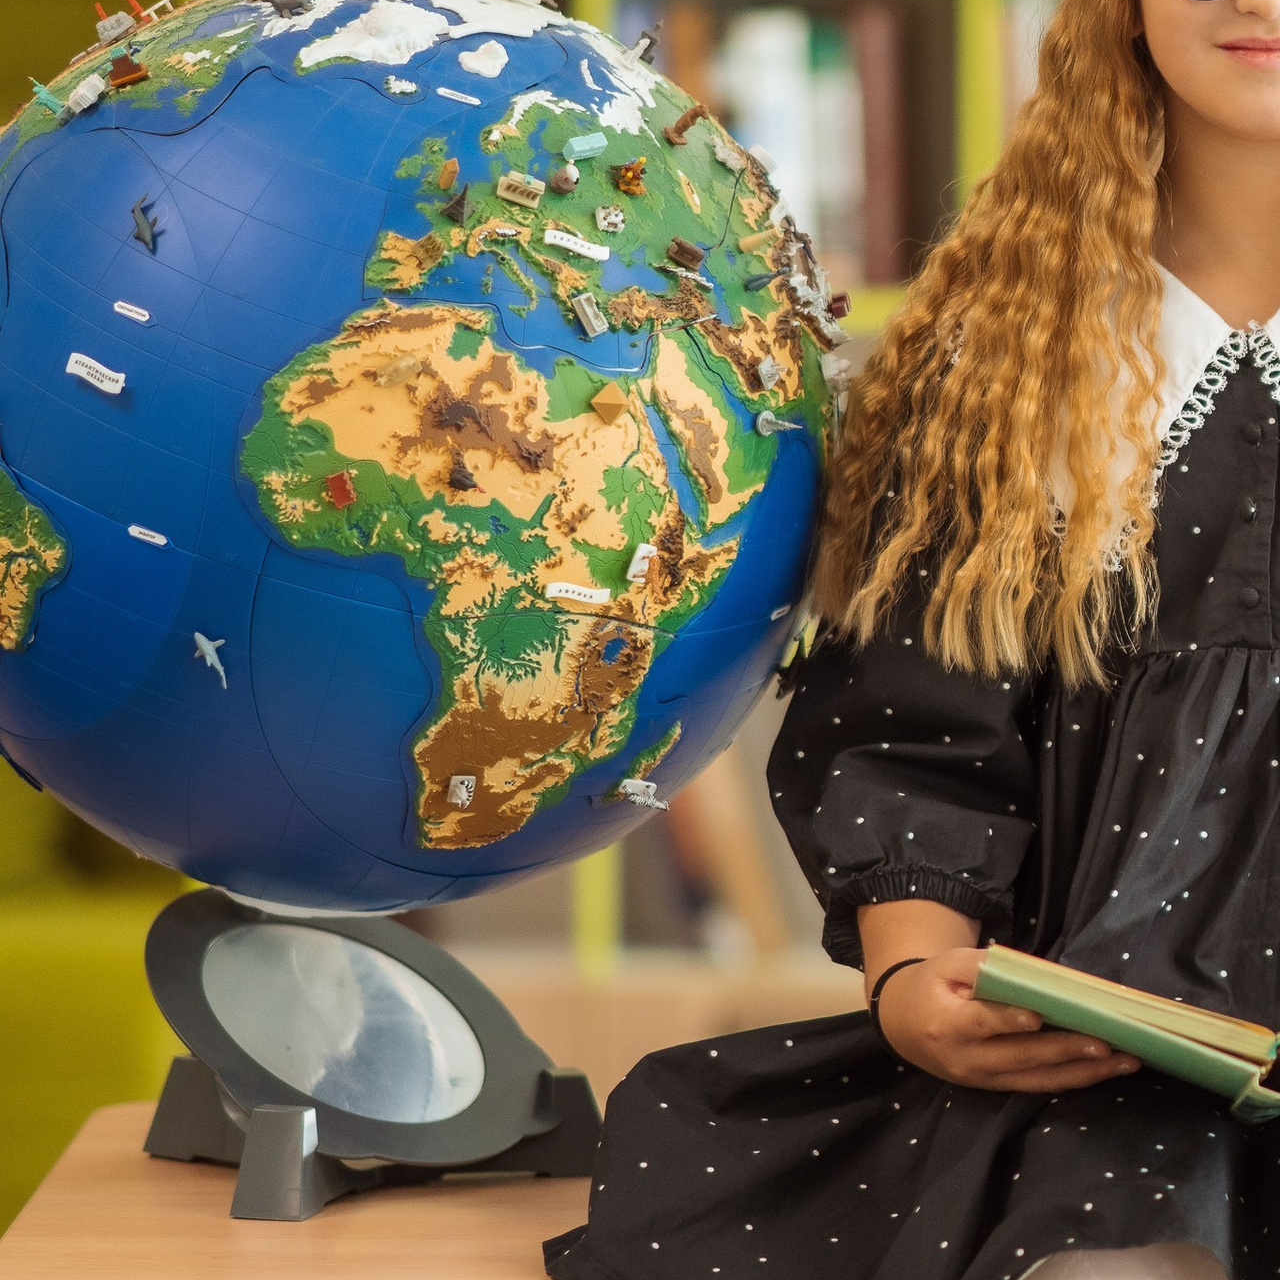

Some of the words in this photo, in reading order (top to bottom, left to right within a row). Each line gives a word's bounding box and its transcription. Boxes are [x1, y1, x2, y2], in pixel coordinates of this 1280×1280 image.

[74, 359, 120, 384] АТЛАНТИЧЕСКИЙ
[86, 370, 105, 384] ОКЕАН
[558, 588, 593, 600] АФРИКА
